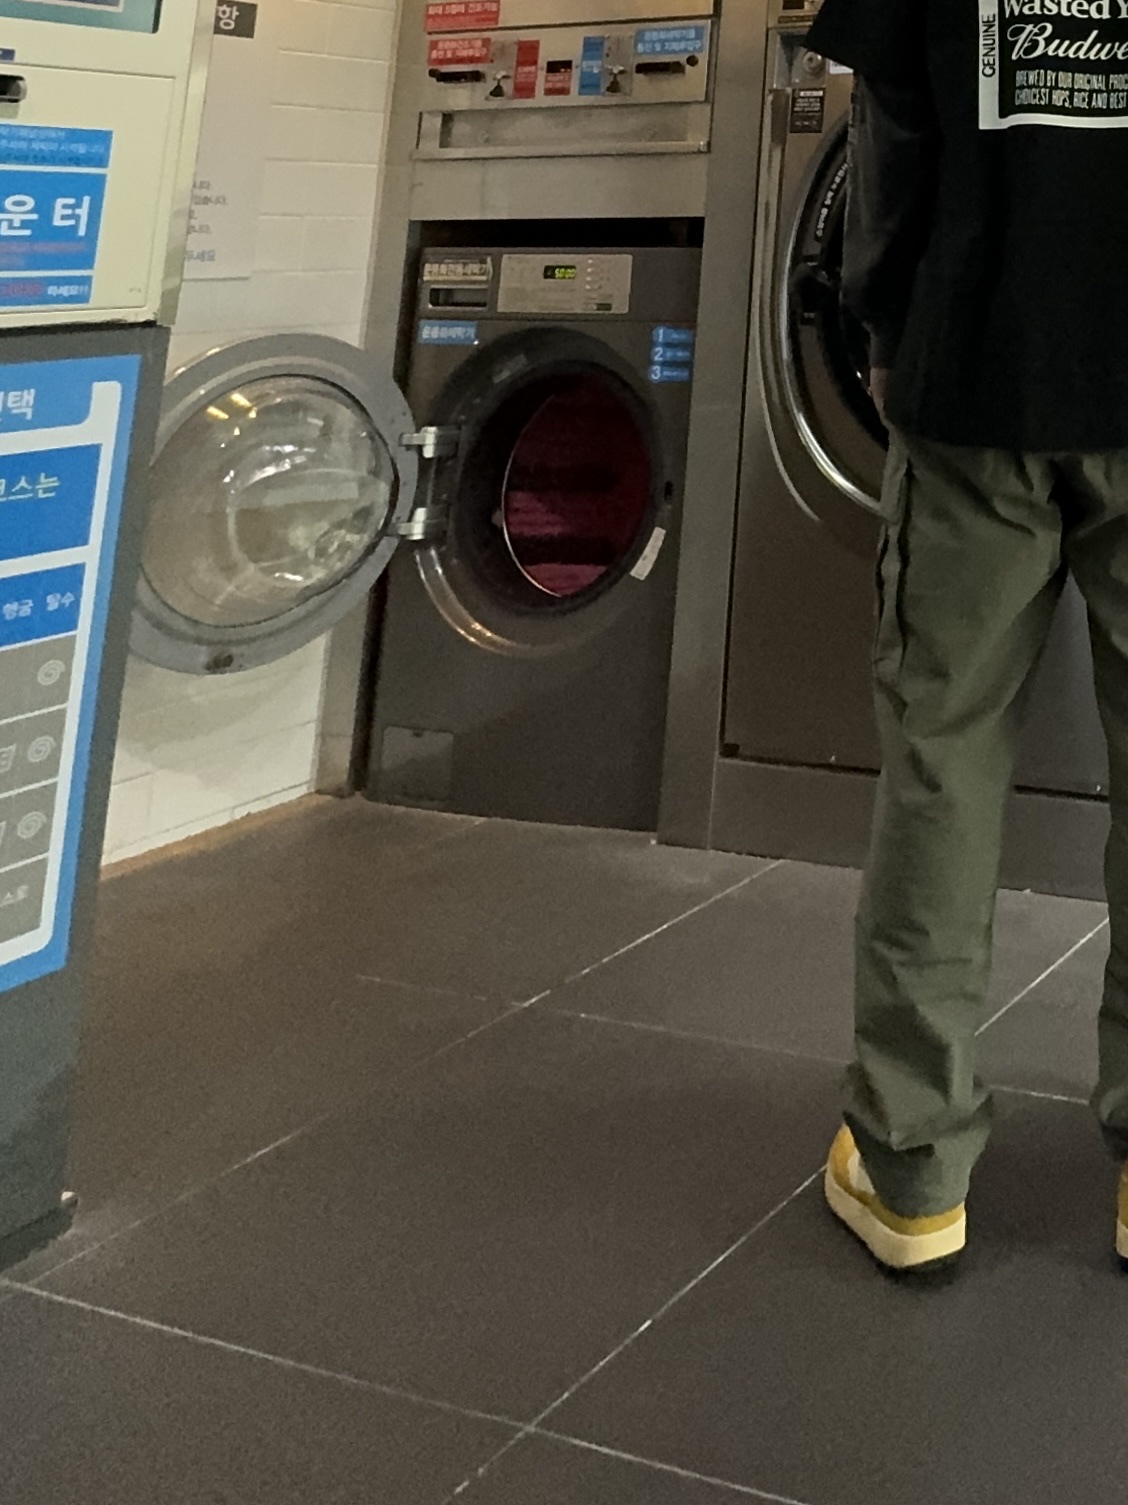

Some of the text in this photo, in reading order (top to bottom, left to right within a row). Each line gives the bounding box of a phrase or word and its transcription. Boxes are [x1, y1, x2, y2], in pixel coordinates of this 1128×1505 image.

[982, 13, 998, 78] GENUINE
[1016, 69, 1045, 88] BREWED
[1046, 70, 1056, 87] BY
[1058, 71, 1072, 89] OUR
[1074, 72, 1106, 90] ORIGINAL
[1015, 88, 1049, 106] CHOICEST
[1073, 91, 1089, 109] RICE
[1091, 91, 1108, 109] AND
[1109, 91, 1128, 109] BEST
[655, 347, 664, 361] 2
[651, 366, 661, 380] 3
